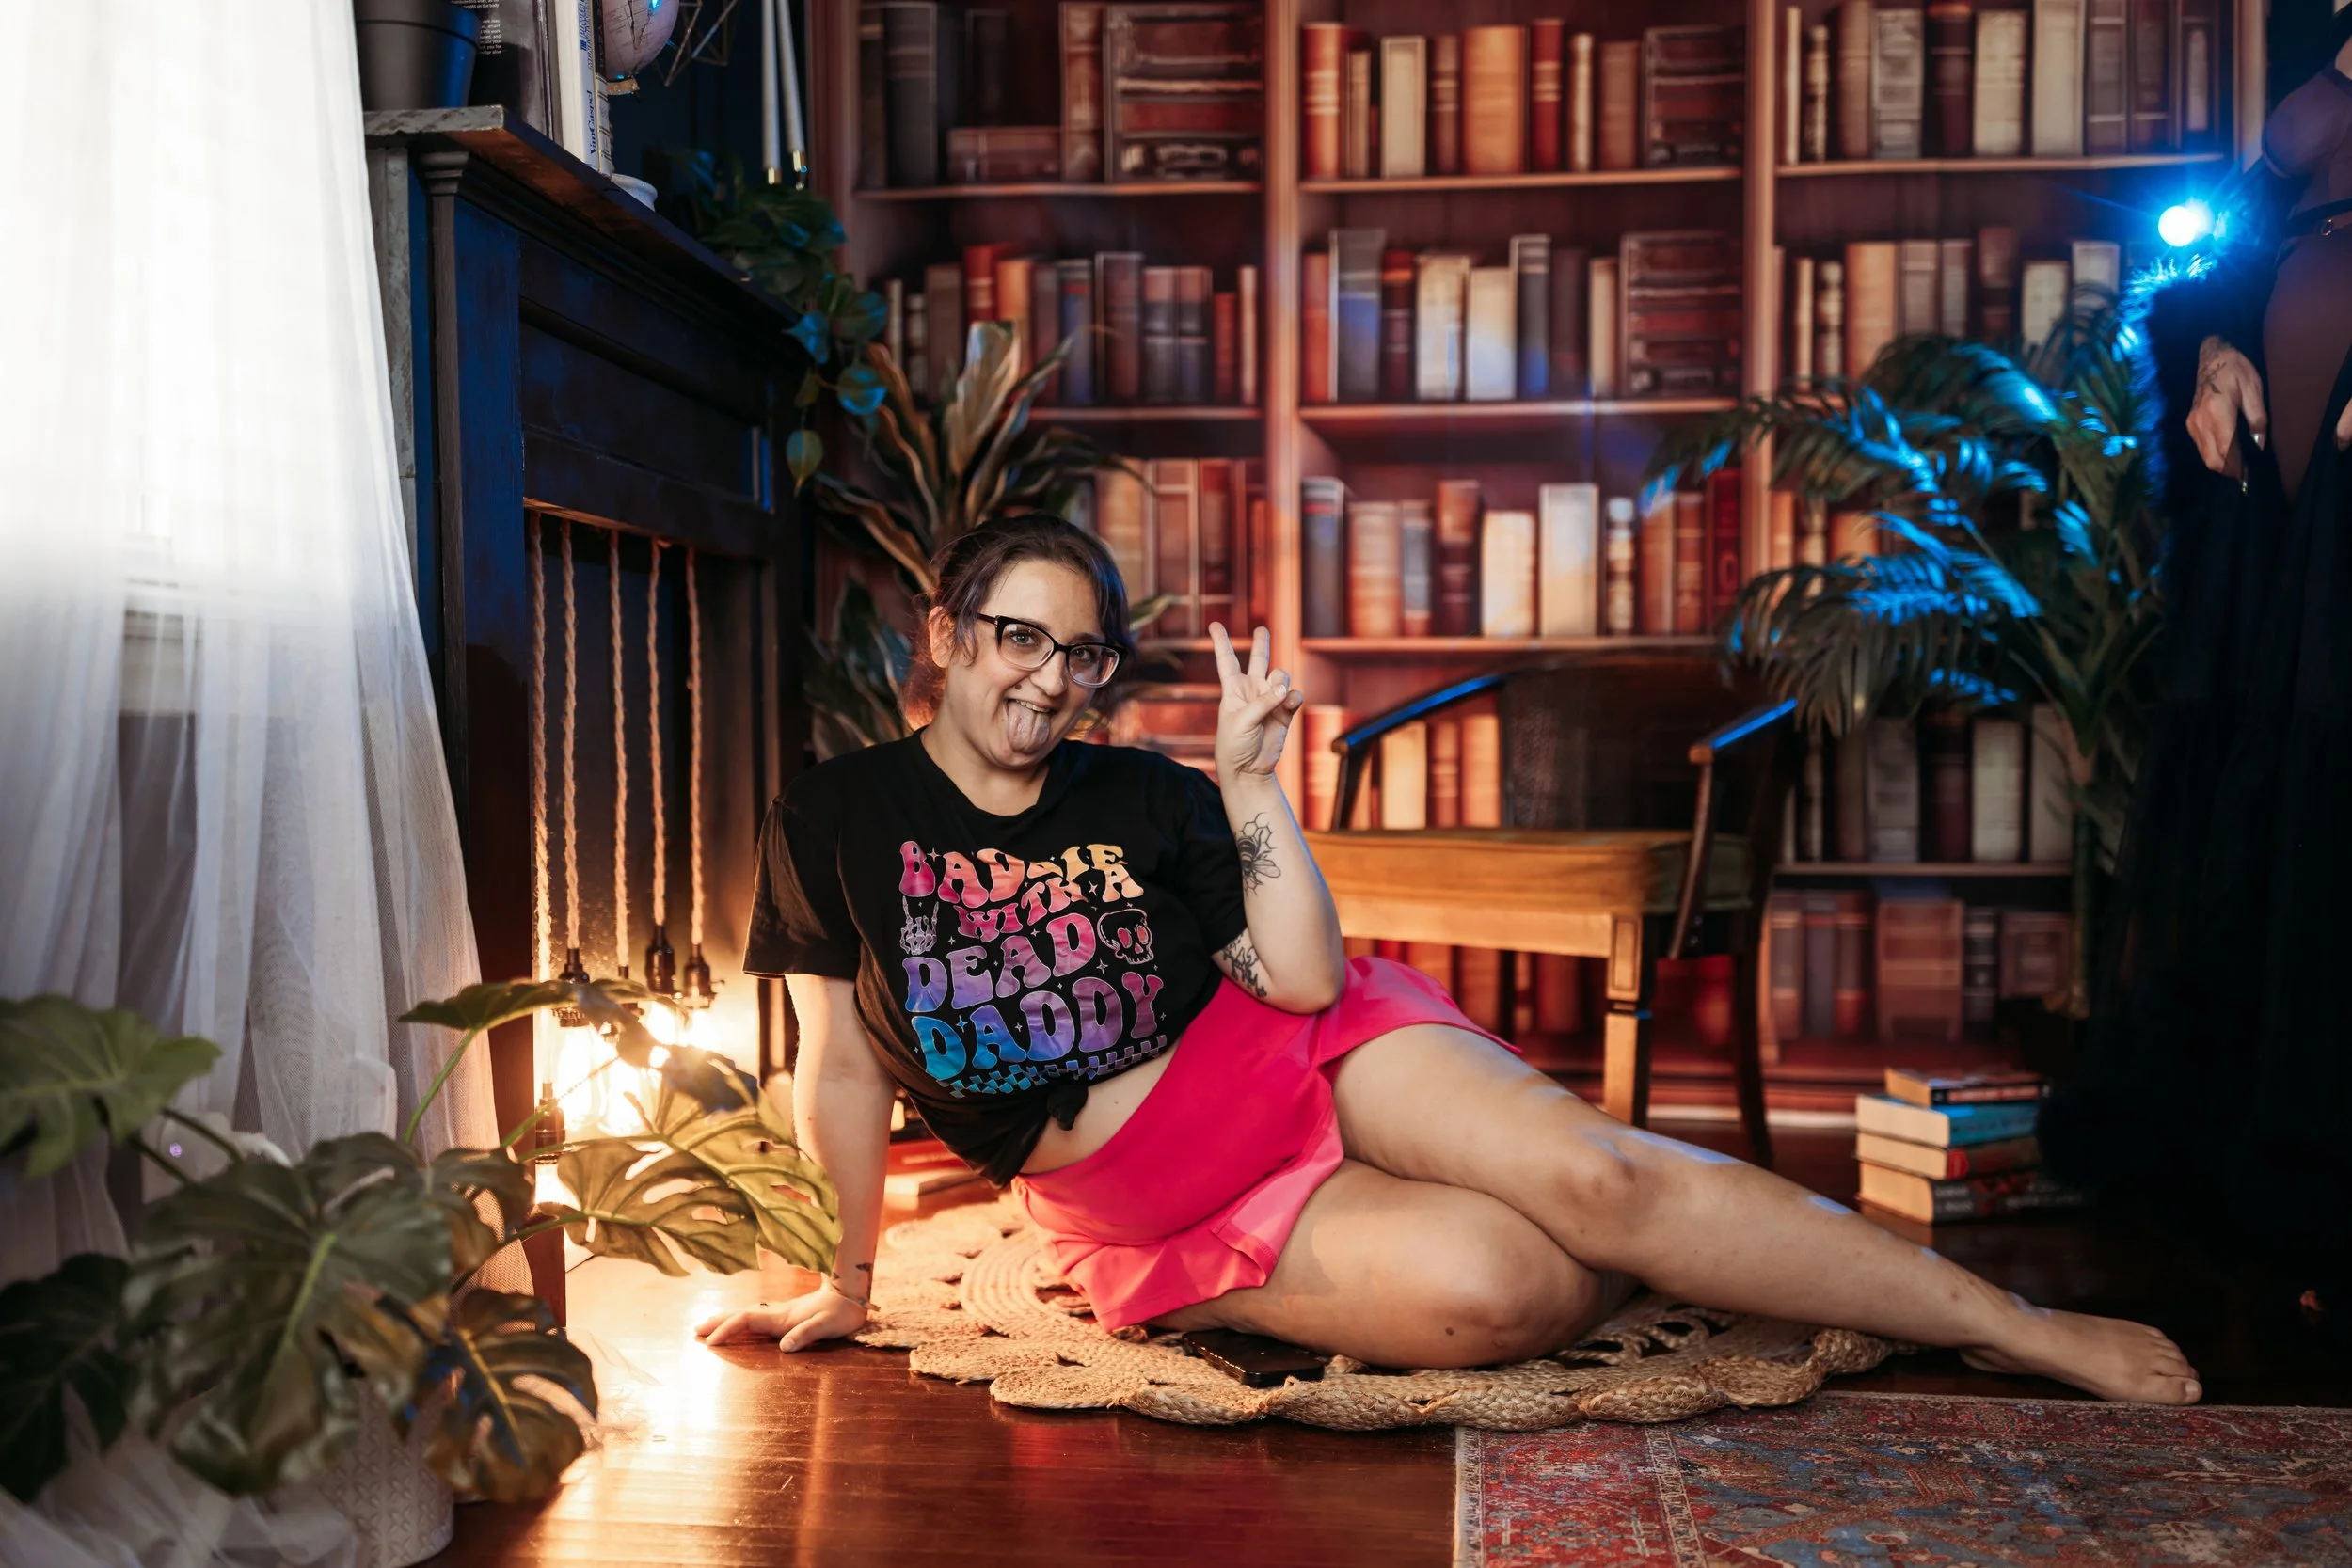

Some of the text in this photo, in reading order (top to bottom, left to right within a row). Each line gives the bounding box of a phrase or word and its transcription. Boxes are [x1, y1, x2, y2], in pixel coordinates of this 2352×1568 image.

[587, 90, 596, 154] VanCaspel
[899, 840, 1128, 909] BADIE
[953, 876, 1089, 942] WITH
[901, 912, 1097, 1014] DEAD
[911, 971, 1165, 1081] DADDY
